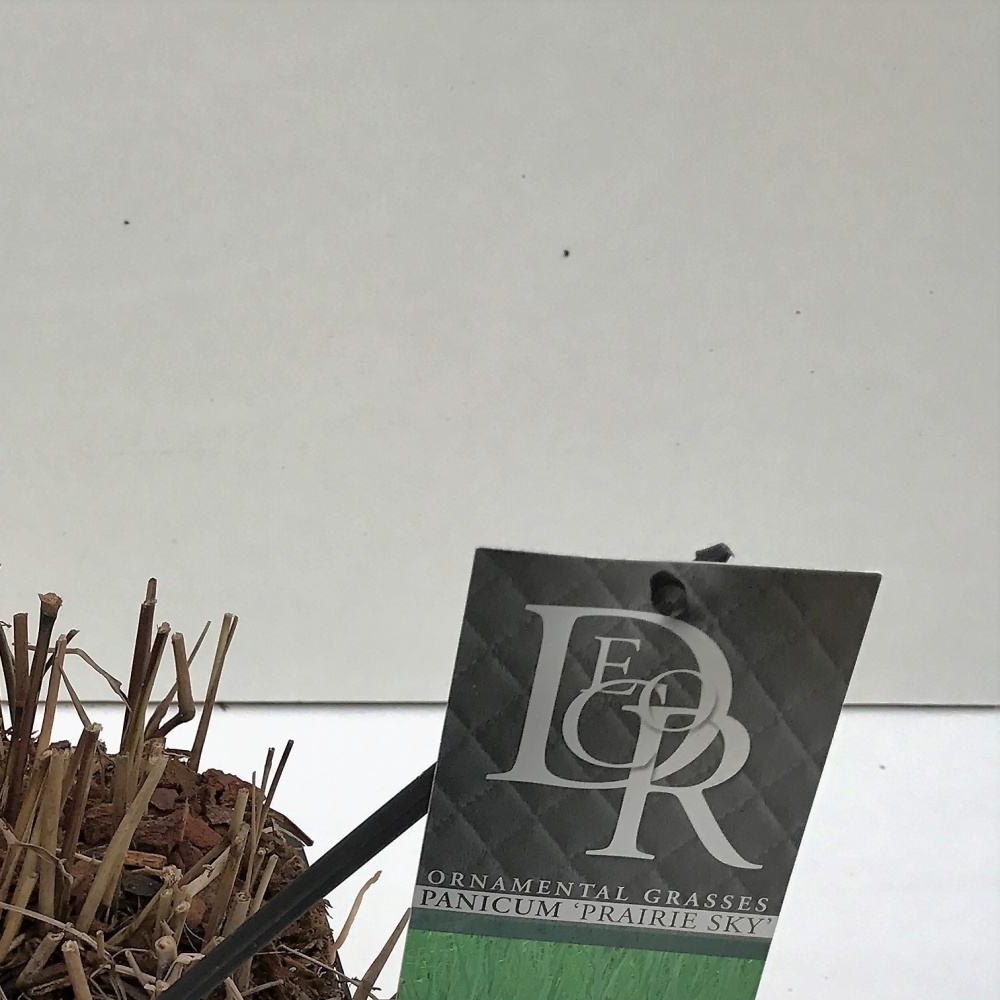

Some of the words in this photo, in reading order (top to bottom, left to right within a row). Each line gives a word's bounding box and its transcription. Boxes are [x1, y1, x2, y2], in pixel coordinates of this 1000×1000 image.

[419, 889, 562, 918] PANICUM
[427, 868, 629, 902] ORNAMENTAL
[644, 887, 769, 913] GRASSES
